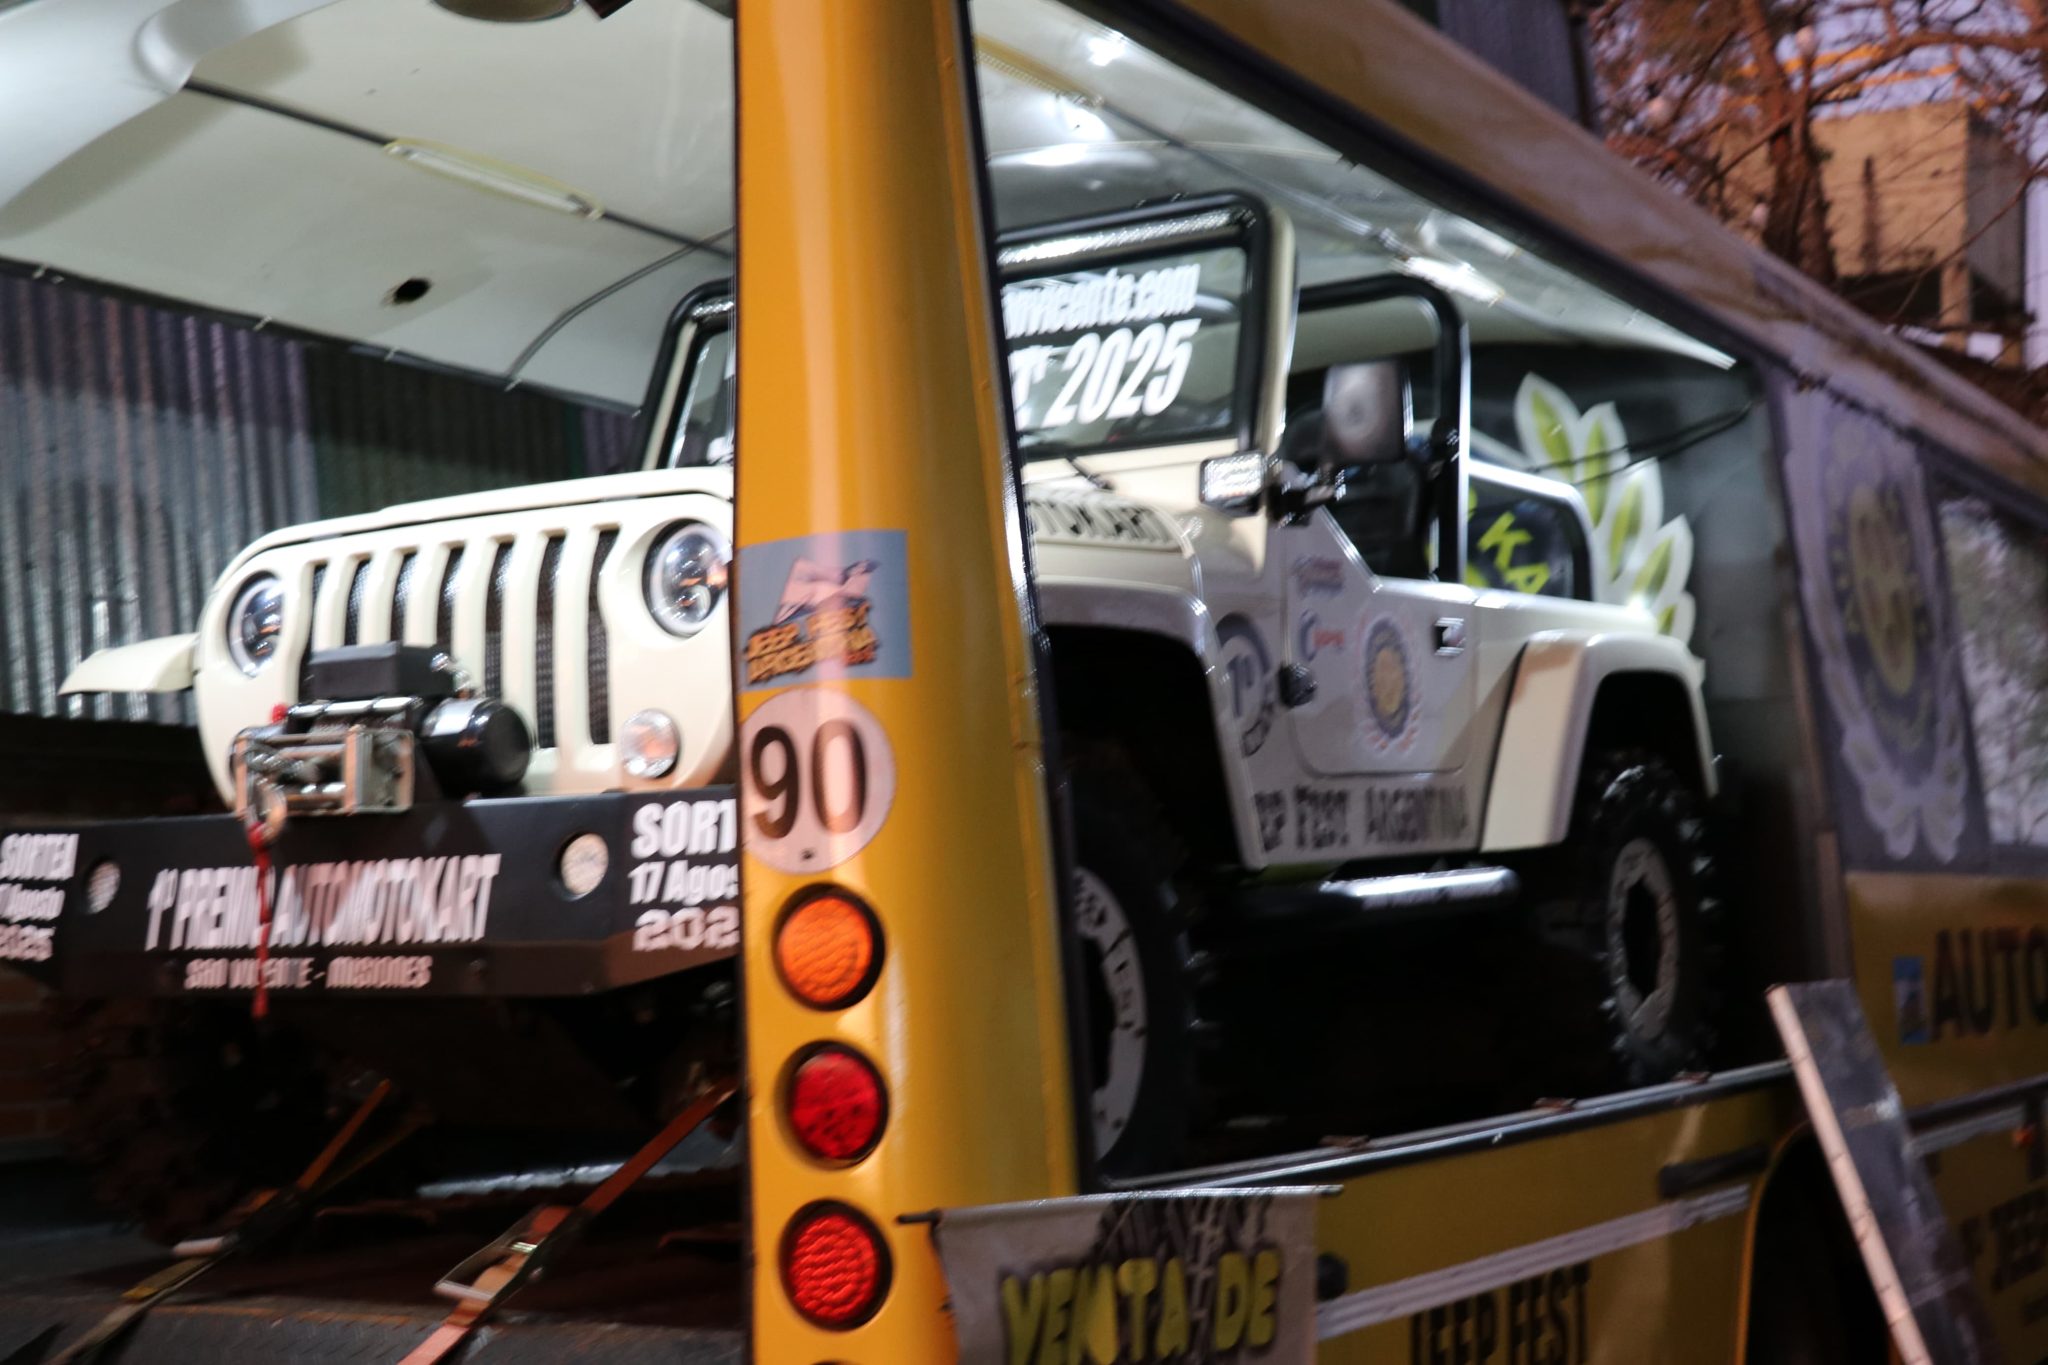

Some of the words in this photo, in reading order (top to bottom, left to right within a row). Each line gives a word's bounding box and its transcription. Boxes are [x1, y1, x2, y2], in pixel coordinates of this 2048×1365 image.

[1040, 318, 1202, 428] 2025
[631, 799, 737, 860] SORT
[750, 719, 868, 840] 90
[268, 853, 502, 948] AUTOMOTOKART
[628, 861, 666, 905] 17
[1000, 1254, 1190, 1365] VENTA
[1213, 1247, 1281, 1351] DE
